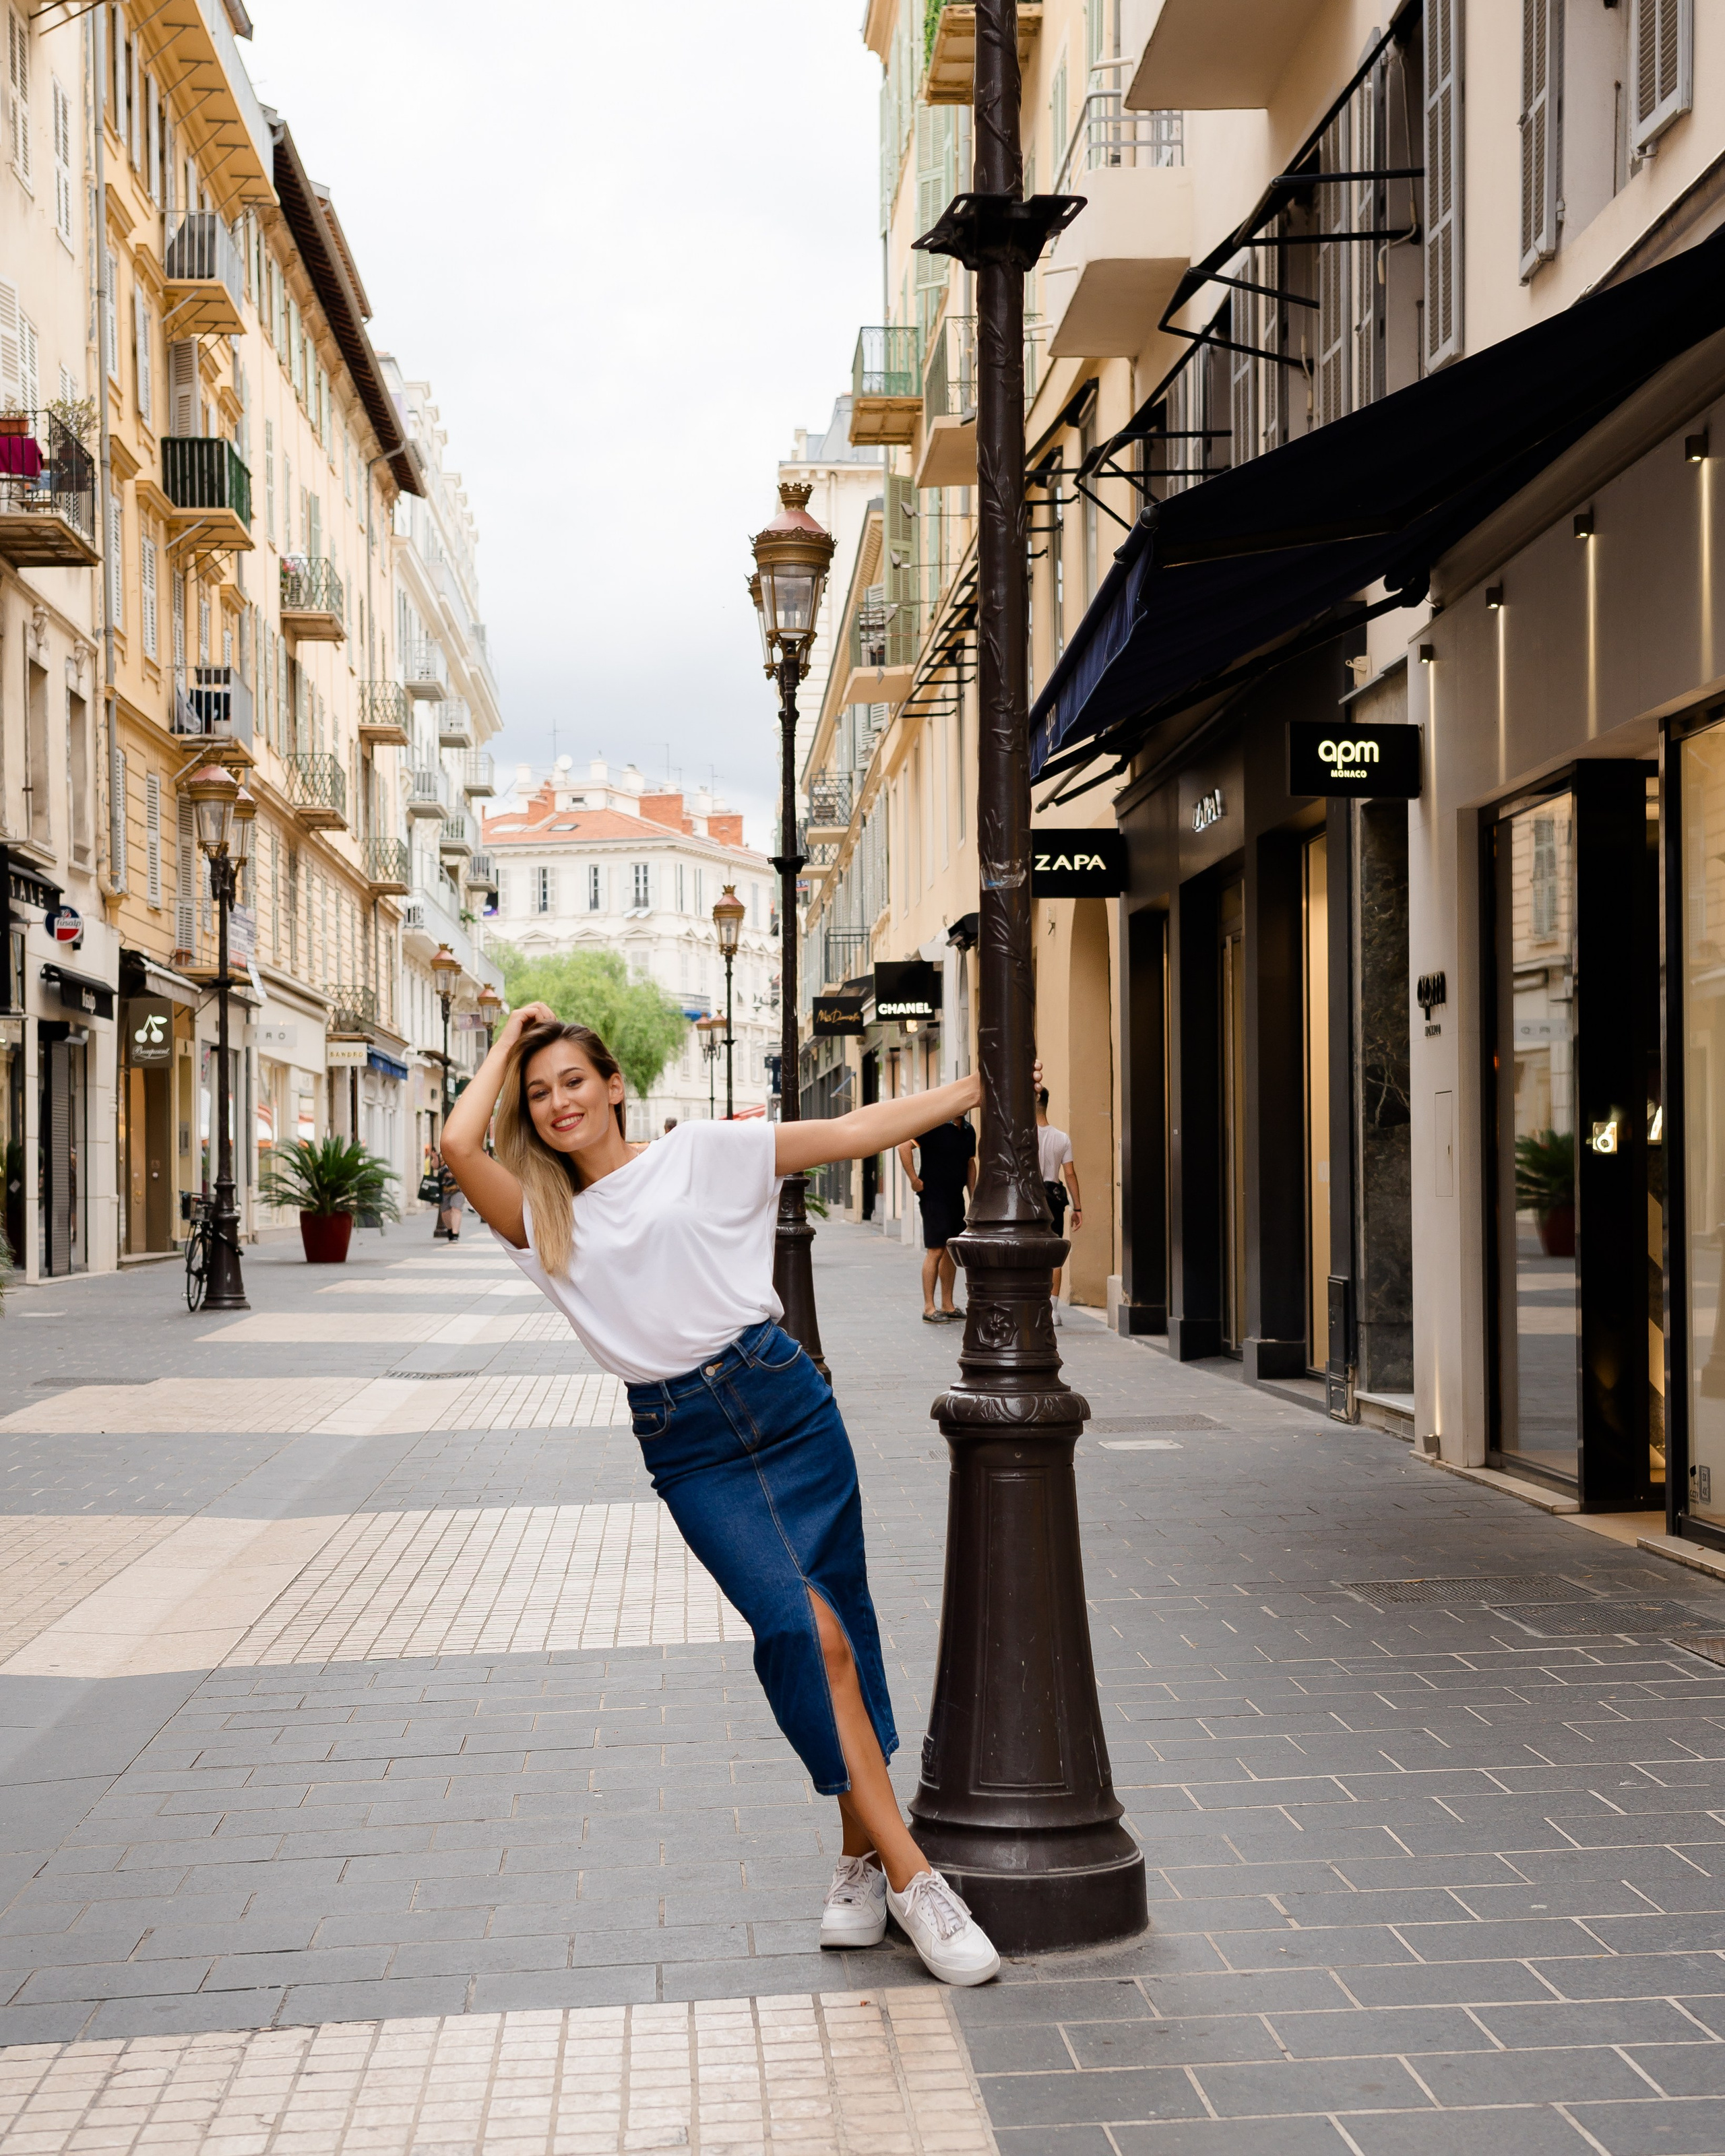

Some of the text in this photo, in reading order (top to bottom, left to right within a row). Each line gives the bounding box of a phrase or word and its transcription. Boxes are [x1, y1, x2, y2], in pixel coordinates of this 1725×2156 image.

[1318, 740, 1379, 769] apm
[1330, 769, 1368, 778] MONACO
[1034, 854, 1107, 870] ZAPA
[57, 918, 82, 928] fusalp
[1417, 971, 1446, 1021] apm
[877, 1002, 933, 1015] CHANEL
